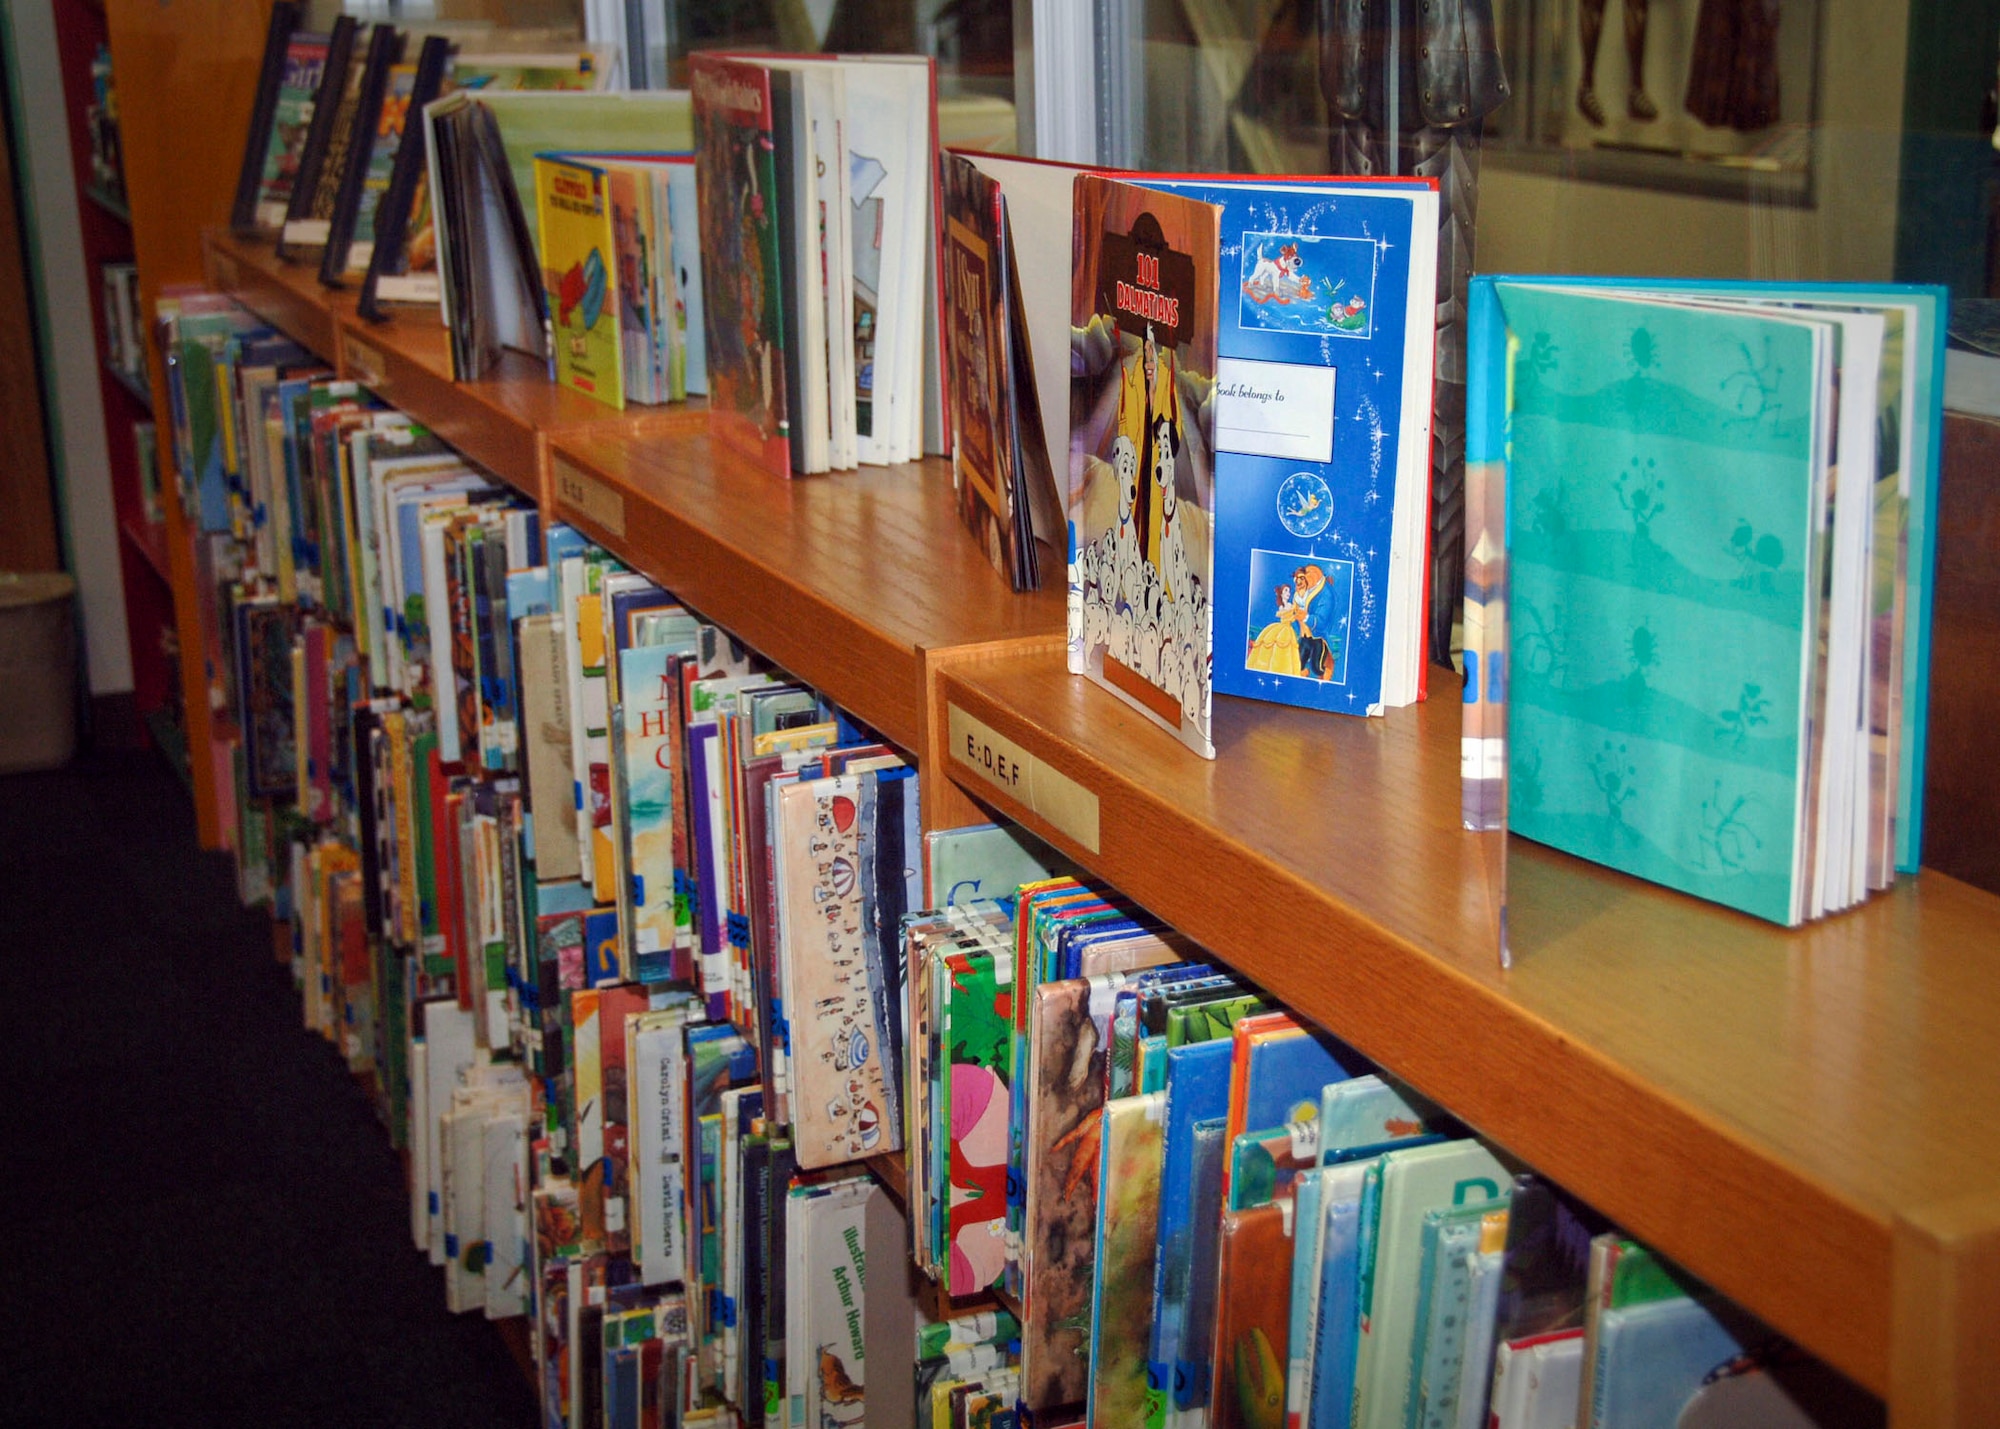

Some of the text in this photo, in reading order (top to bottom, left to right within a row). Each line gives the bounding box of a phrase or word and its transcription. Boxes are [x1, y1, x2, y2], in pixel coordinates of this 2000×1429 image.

[1136, 252, 1160, 291] 101
[1116, 280, 1179, 328] DALMATIANS
[1216, 381, 1285, 404] book belongs to
[659, 1057, 672, 1106] Carolyn
[662, 1174, 673, 1209] David
[843, 1225, 866, 1292] illustra
[832, 1265, 865, 1361] Arthur Howard
